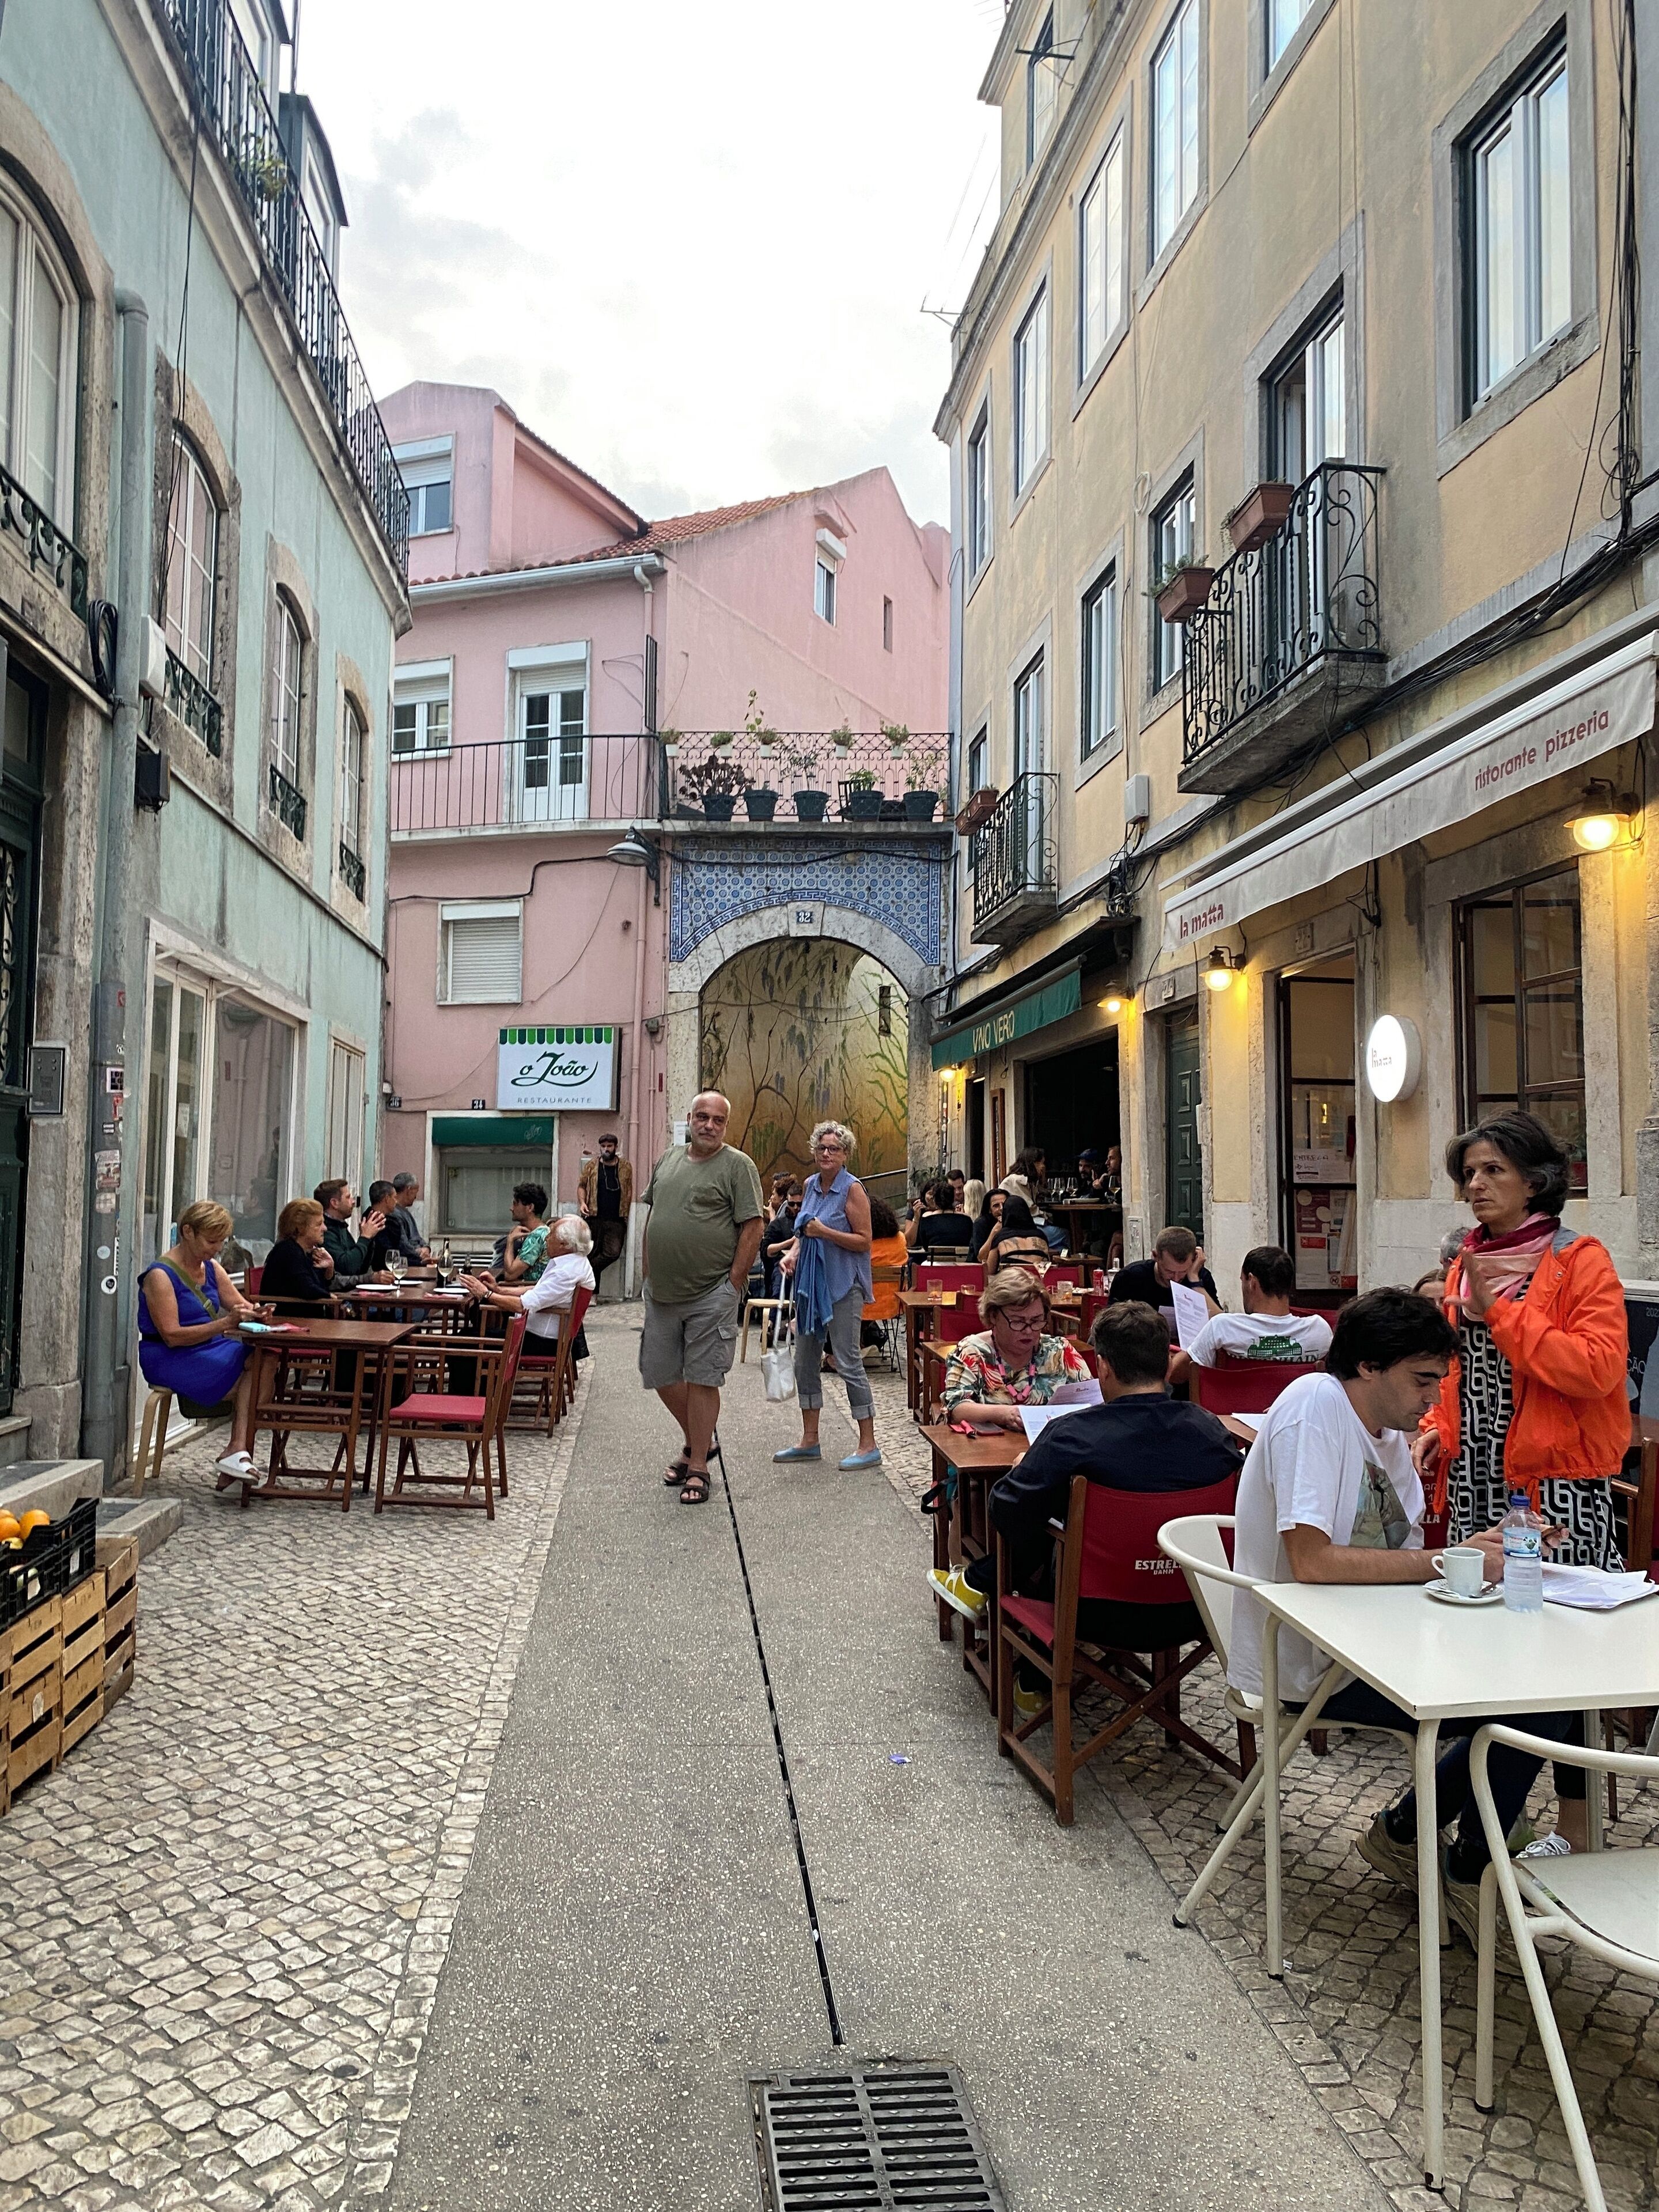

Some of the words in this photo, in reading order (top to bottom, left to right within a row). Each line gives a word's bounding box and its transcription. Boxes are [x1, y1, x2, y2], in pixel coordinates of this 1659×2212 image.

[1475, 747, 1537, 791] ristorante
[1546, 710, 1609, 762] pizzeria
[799, 911, 810, 923] 32
[1180, 914, 1188, 939] la
[1191, 903, 1224, 934] matta
[972, 1022, 991, 1053] VINO
[993, 1010, 1015, 1045] VERO
[511, 1051, 598, 1086] João
[520, 1064, 534, 1075] o
[390, 1097, 399, 1107] 36
[474, 1100, 483, 1109] 34
[1646, 1307, 1659, 1317] 202
[1135, 1559, 1181, 1570] ESTREL
